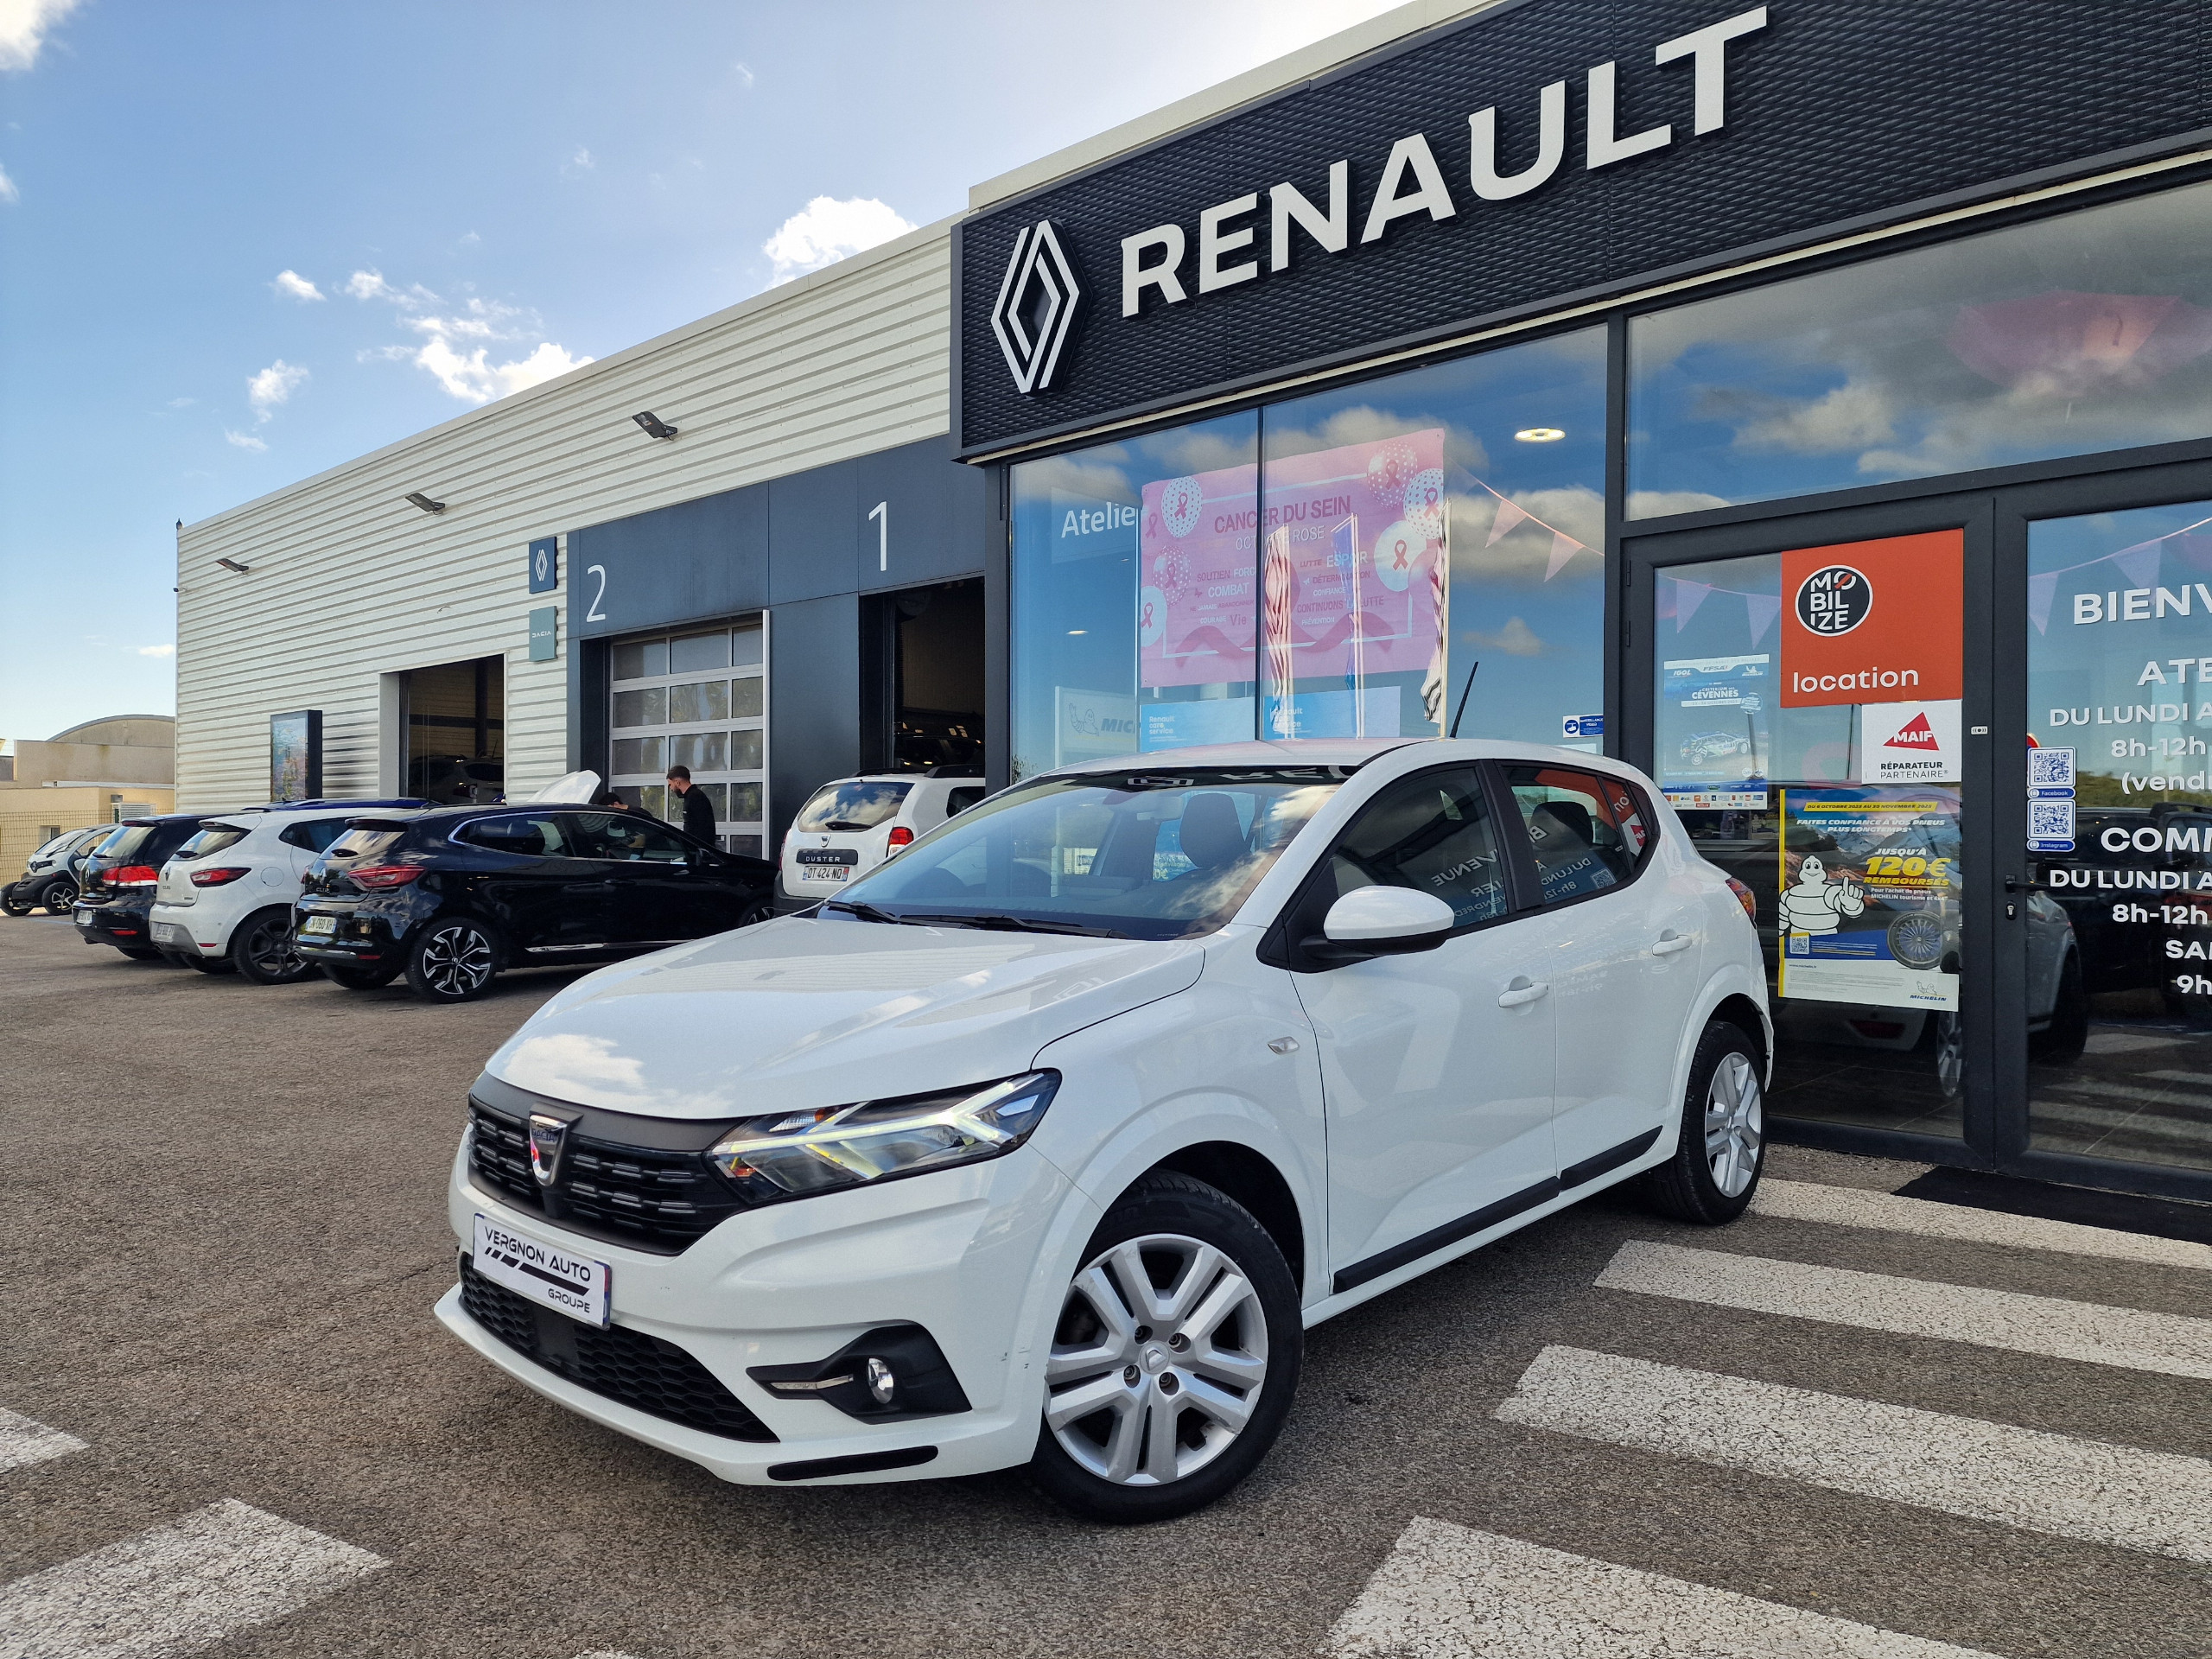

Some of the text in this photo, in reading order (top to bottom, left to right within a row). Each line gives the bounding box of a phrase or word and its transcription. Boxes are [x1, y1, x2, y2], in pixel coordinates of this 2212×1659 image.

[1121, 6, 1768, 318] RENAULT
[1283, 501, 1307, 524] DU
[1310, 495, 1351, 519] SEIN
[868, 501, 887, 572] 1
[1293, 524, 1325, 543] ROSE
[1300, 550, 1368, 568] LUTTE ESPOR
[1197, 566, 1256, 582] SOUTIEN FORC
[586, 564, 606, 622] 2
[1208, 582, 1249, 598] COMBAT
[1313, 586, 1347, 596] CONFIANCE
[1810, 590, 1849, 612] BIL
[1297, 600, 1344, 613] CONTINUONS
[1230, 613, 1247, 626] Vie
[1810, 609, 1848, 631] IZE
[531, 630, 552, 639] DACIA
[1793, 666, 1919, 694] location
[1692, 690, 1739, 700] CÉVENNES
[2050, 707, 2090, 727] DU
[2097, 702, 2189, 725] LUNDI
[1893, 730, 1934, 744] MAIF
[2111, 735, 2206, 759] 8h-12h
[1880, 760, 1943, 771] RÉPARATEUR
[2101, 827, 2212, 853] COM
[1863, 876, 1951, 887] REMBOURSÉS
[2050, 869, 2091, 888] DU
[2097, 870, 2189, 890] LUNDI
[2112, 903, 2208, 925] 8h-12h
[2165, 939, 2212, 961] SA
[484, 1225, 591, 1283] VERGNON AUTO
[548, 1287, 591, 1314] GROUPE
